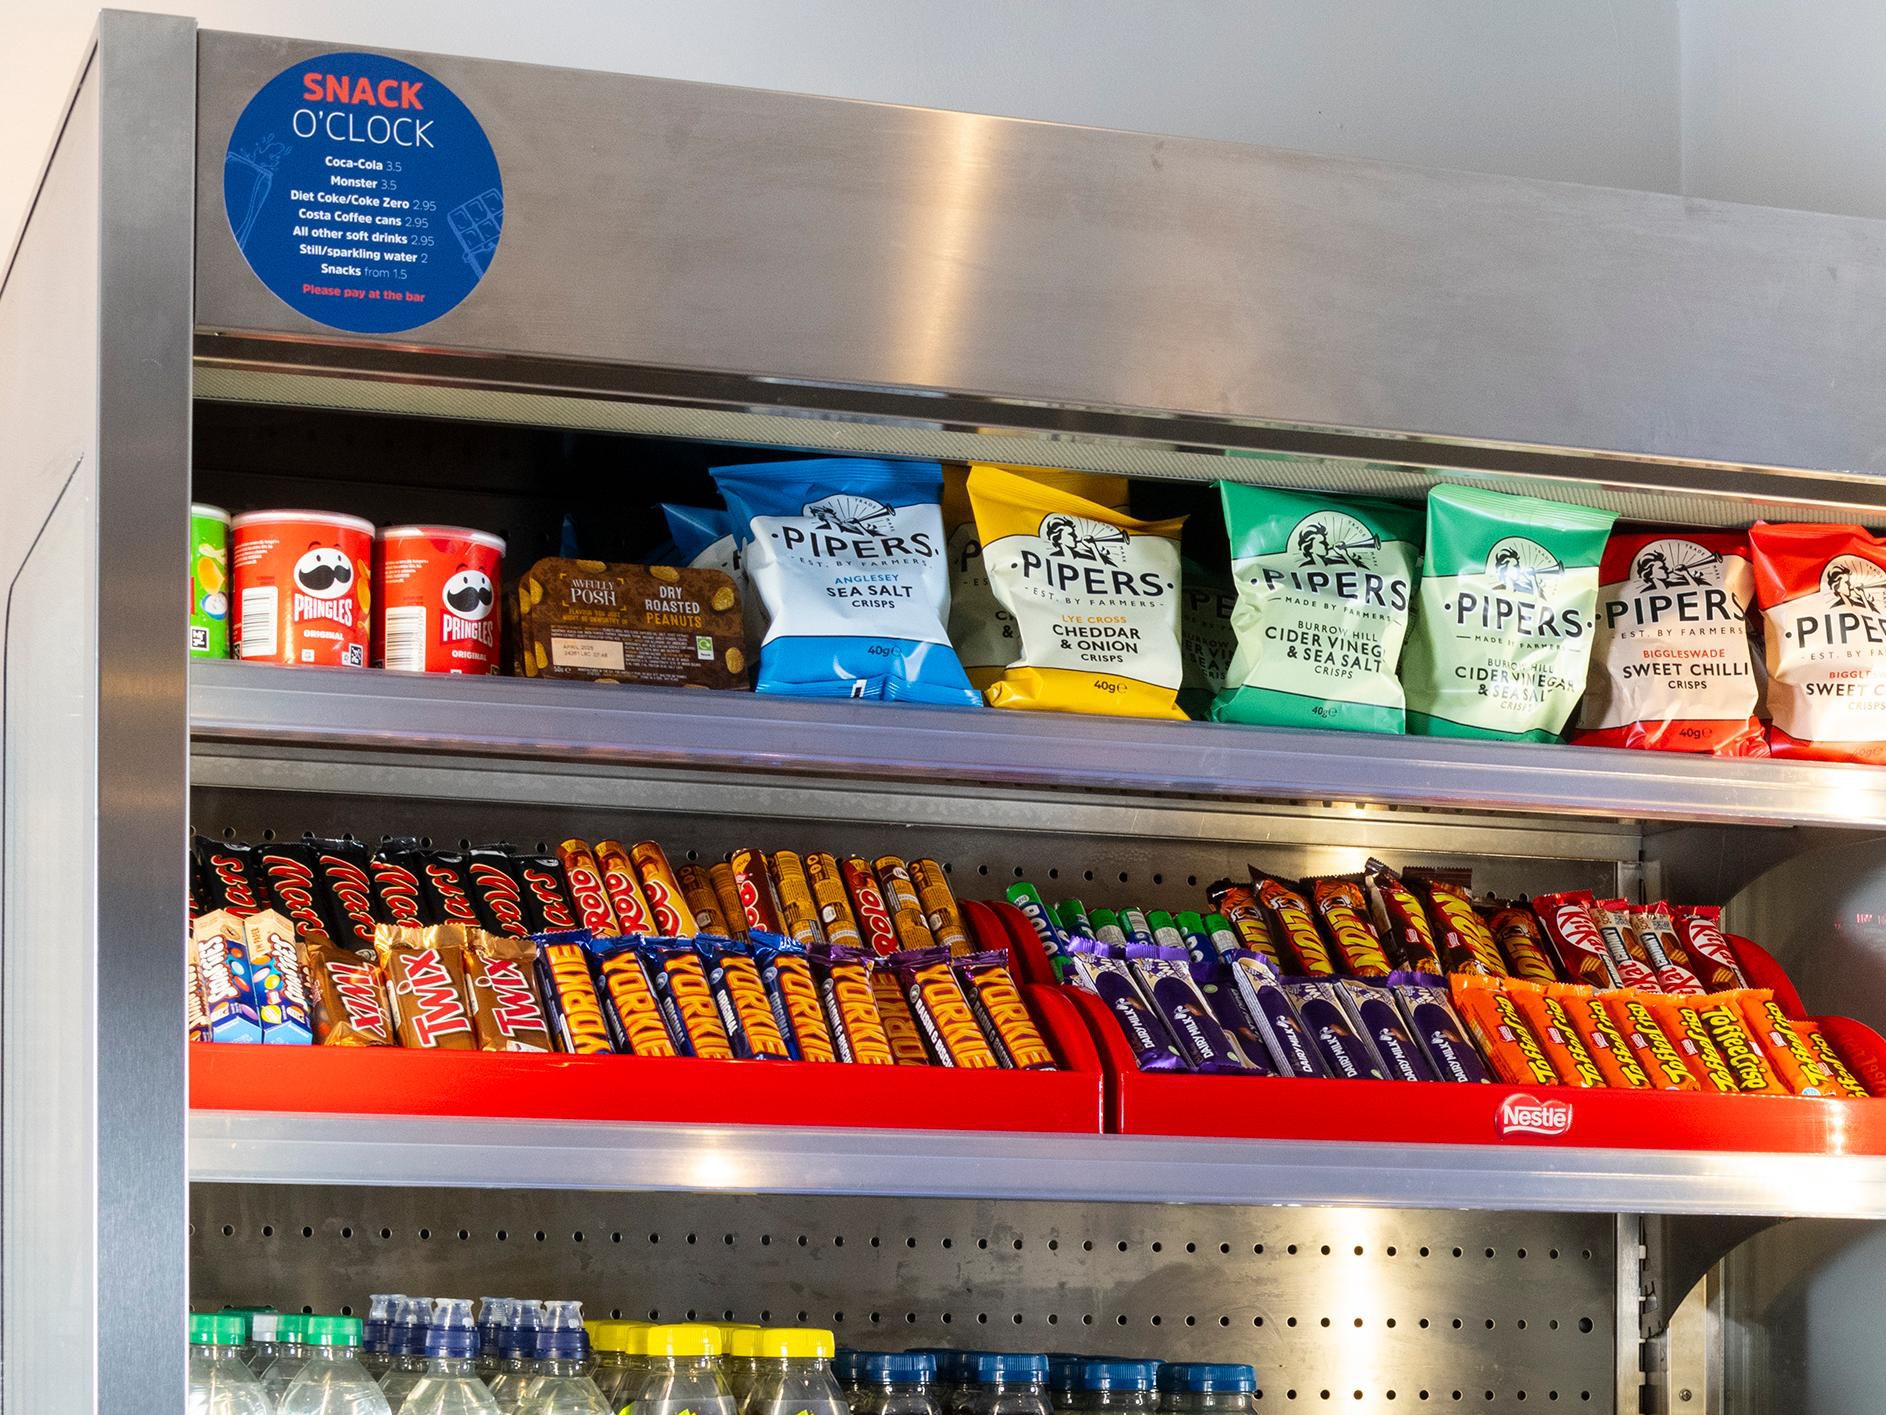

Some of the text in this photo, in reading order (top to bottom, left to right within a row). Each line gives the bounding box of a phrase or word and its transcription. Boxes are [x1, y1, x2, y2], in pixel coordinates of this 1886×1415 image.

[304, 72, 423, 110] SNACK
[293, 109, 434, 148] O'CLOCK
[325, 156, 401, 171] Coca-Cola 3.5
[331, 176, 396, 190] Monster 3.5
[291, 190, 436, 210] Diet Coke/Coke Zero 2.95
[299, 208, 428, 228] Costa Coffee cans 2.95
[293, 226, 434, 246] All other soft drinks 2.95
[300, 244, 427, 263] Still/sparkling water 2
[321, 264, 407, 279] Snacks from 1.5
[303, 284, 425, 302] Please pay at the bar
[782, 526, 932, 558] PIPERS
[835, 574, 899, 584] ANGLESEY
[1022, 550, 1164, 596] PIPERS
[571, 587, 616, 606] POSH
[660, 586, 683, 600] DRY
[826, 585, 912, 598] SEA SALT
[1262, 568, 1407, 611] PIPERS
[294, 593, 352, 627] PRINGLES
[645, 599, 700, 614] ROASTED
[852, 600, 895, 608] CRISPS
[1285, 596, 1316, 607] MADE
[1324, 603, 1337, 611] BY
[1606, 589, 1746, 629] PIPERS
[646, 612, 702, 628] PEANUTS
[1062, 615, 1083, 623] LYE
[1457, 592, 1582, 638] PIPERS
[304, 630, 344, 641] ORIGINAL
[443, 614, 493, 648] PRINGLES
[1053, 624, 1141, 639] CHEDDAR
[1265, 627, 1321, 647] CIDER
[1353, 631, 1378, 642] HILL
[1681, 627, 1743, 636] FARMERS
[1061, 639, 1138, 654] & ONION
[1643, 649, 1725, 658] BIGGLESWADE
[452, 650, 487, 661] ORIGINAL
[1081, 654, 1123, 663] CRISPS
[1287, 646, 1381, 673] & SEA SALT
[1315, 666, 1353, 679] CRISPS
[1455, 666, 1508, 683] CIDER
[1623, 663, 1748, 678] SWEET CHILLI
[1668, 681, 1707, 689] CRISPS
[1806, 683, 1869, 696] SWEET
[1327, 909, 1392, 974] LION
[396, 949, 471, 1048] TWIX
[475, 954, 547, 1037] TWIX
[716, 989, 738, 1037] ORIGINAL
[720, 956, 789, 1057] YORKIE
[914, 964, 998, 1069] YORKIE
